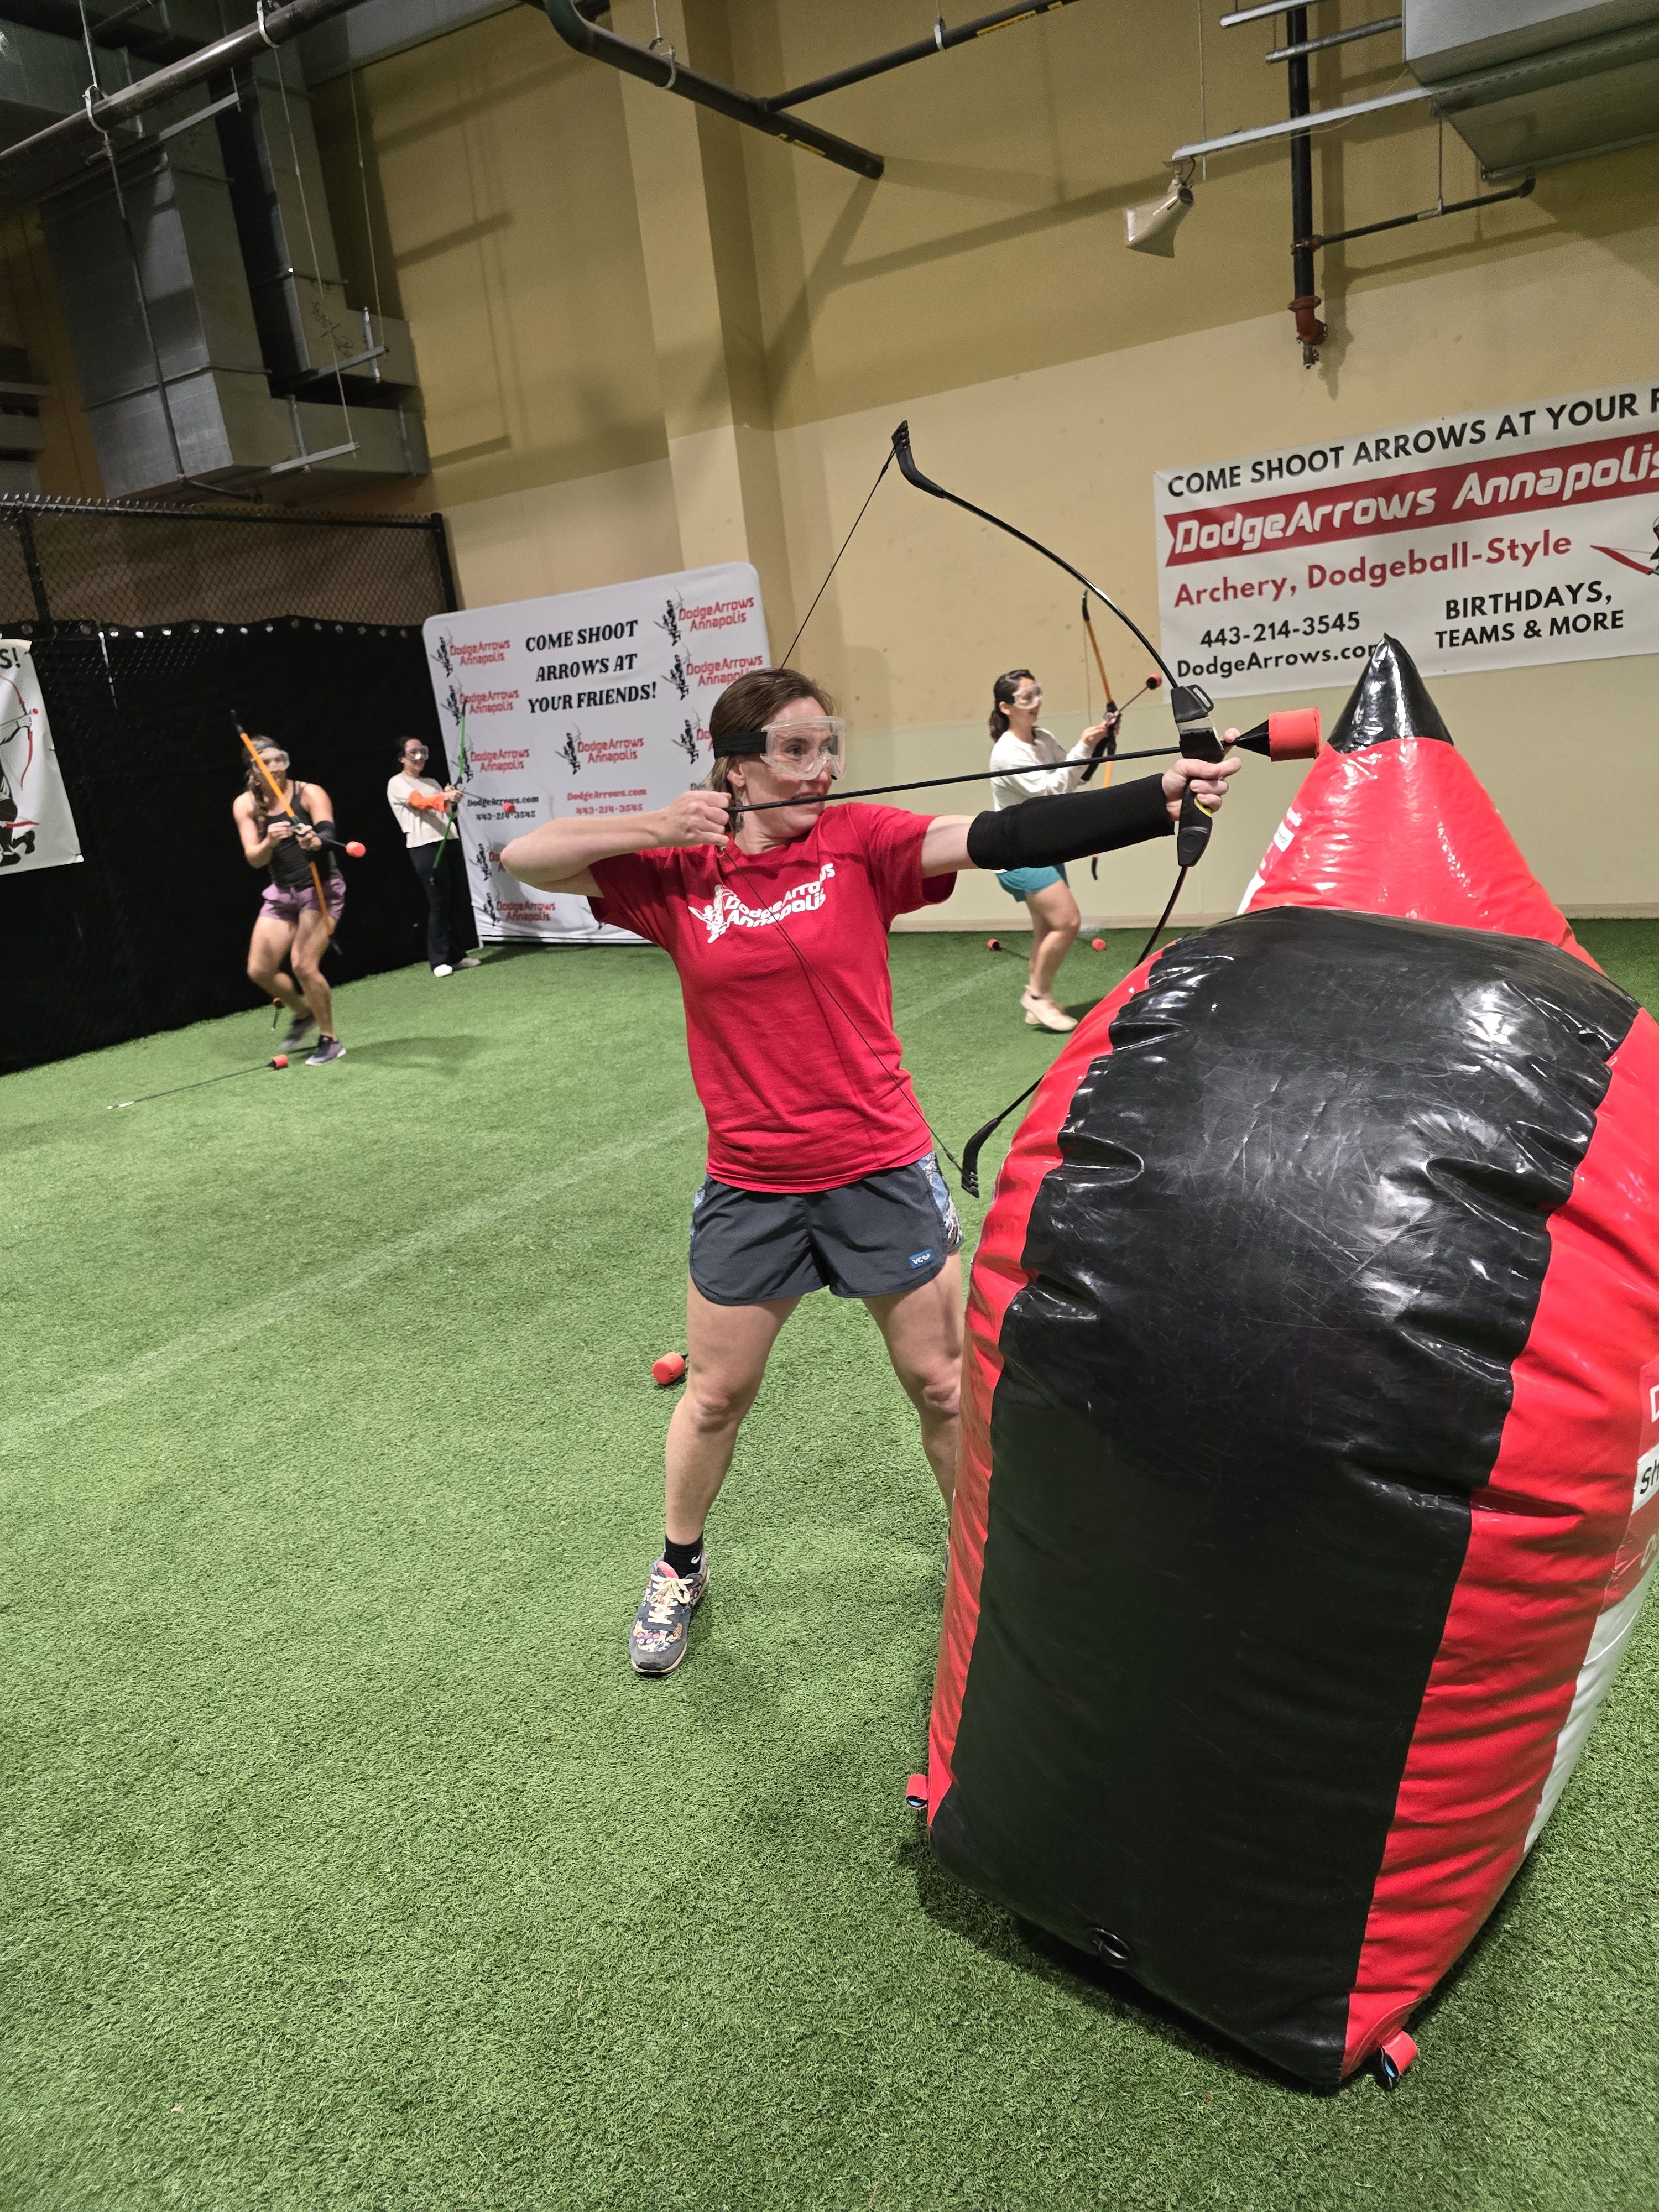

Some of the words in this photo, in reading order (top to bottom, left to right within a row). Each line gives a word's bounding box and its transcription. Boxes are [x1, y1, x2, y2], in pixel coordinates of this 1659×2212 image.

[1168, 465, 1241, 497] COME
[1250, 446, 1344, 484] SHOOT
[1352, 420, 1486, 466] ARROWS
[1495, 410, 1536, 441] AT
[1545, 392, 1640, 430] YOUR
[1175, 487, 1437, 554] DodgeArrows
[1174, 577, 1297, 608] Archery,
[1308, 529, 1572, 589] Dodgeball-Style
[678, 597, 754, 622] DodgeArrows
[1445, 581, 1612, 620] BIRTHDAYS,
[690, 611, 747, 632] Annapolis
[1199, 611, 1360, 648] 443-214-3545
[1435, 623, 1515, 649] TEAMS
[1523, 620, 1543, 639] &
[1549, 609, 1624, 636] MORE
[450, 639, 510, 656] DodgeArrows
[526, 630, 573, 652] COME
[577, 619, 638, 645] SHOOT
[460, 652, 505, 666] Annapolis
[535, 657, 610, 682] ARROWS
[613, 653, 637, 672] AT
[686, 655, 763, 676] DodgeArrows
[469, 701, 514, 714] Annapolis
[528, 694, 573, 713] YOUR
[577, 681, 657, 708] FRIENDS!
[471, 749, 530, 763] DodgeArrows
[577, 738, 644, 753] DodgeArrows
[588, 749, 638, 764] Annapolis
[480, 760, 524, 773] Annapolis
